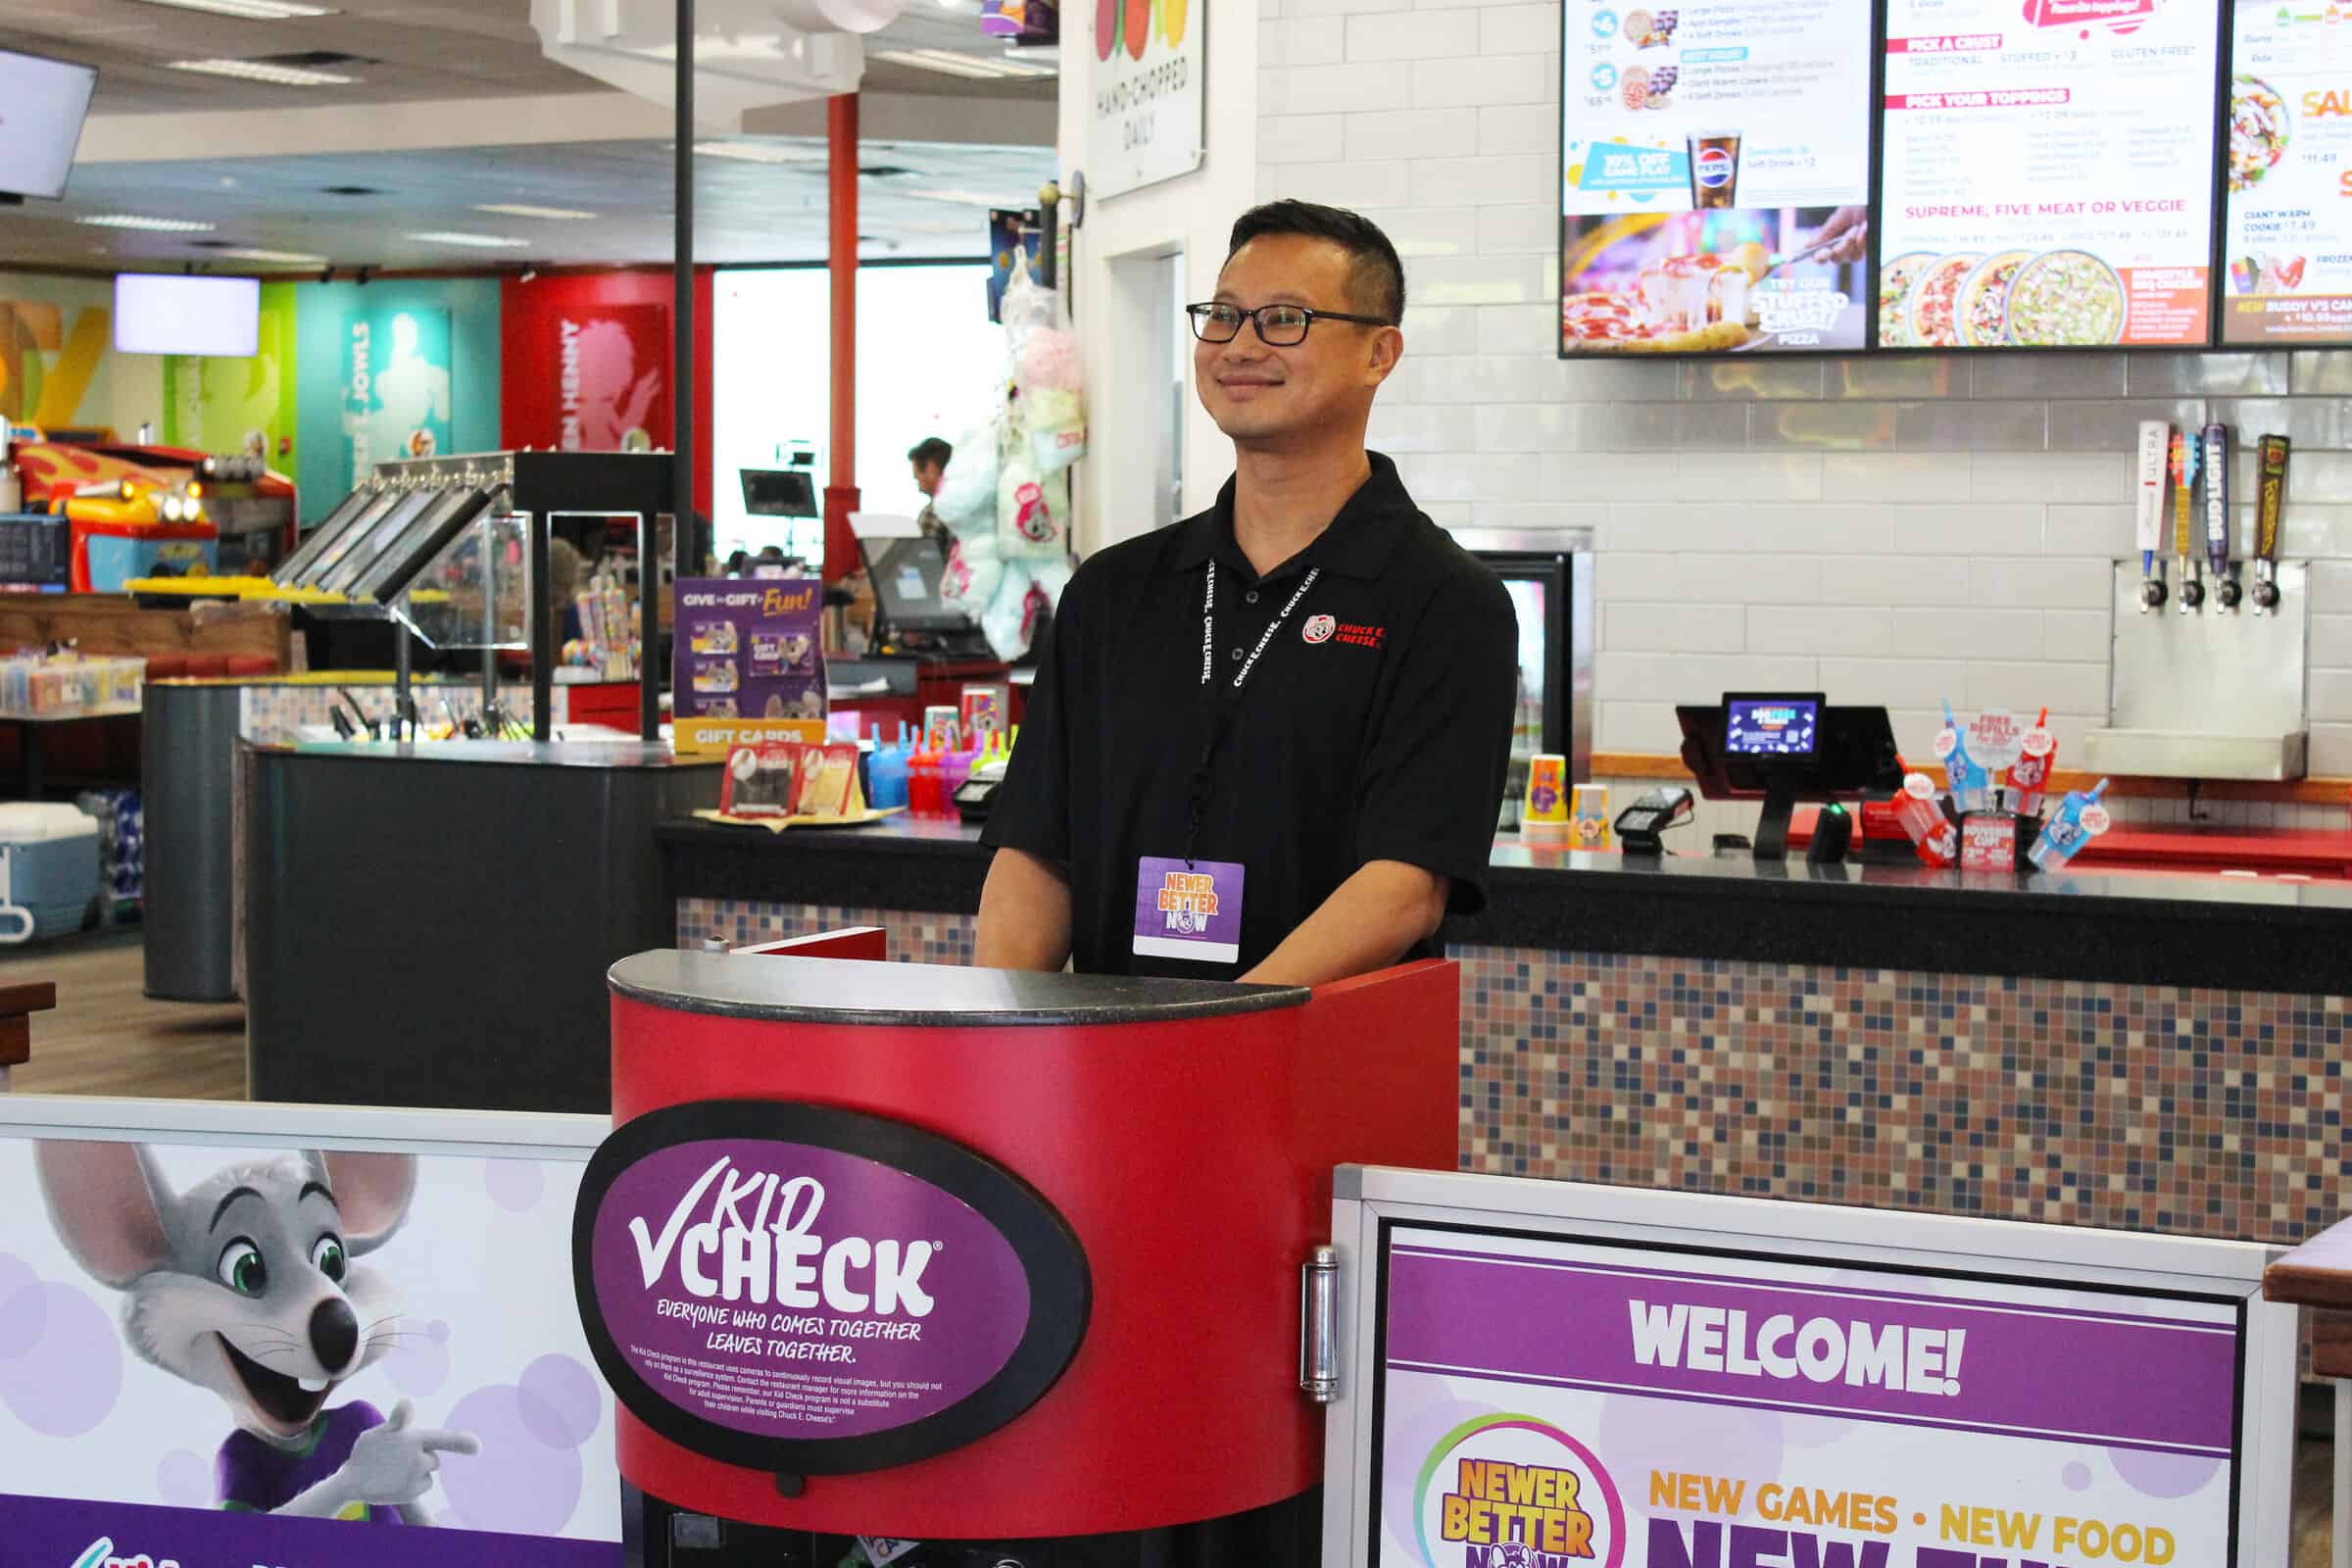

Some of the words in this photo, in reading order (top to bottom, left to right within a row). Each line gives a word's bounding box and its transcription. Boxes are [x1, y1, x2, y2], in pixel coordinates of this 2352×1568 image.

[1907, 38, 1939, 52] PICK
[1941, 36, 1953, 50] A
[1955, 35, 1999, 49] CRUST
[2111, 47, 2157, 59] GLUTEN
[1909, 55, 1983, 67] TRADITIONAL
[1999, 52, 2051, 64] STUFFED
[1907, 95, 1941, 109] PICK
[1943, 93, 1986, 108] YOUR
[1990, 90, 2068, 106] TOPPINGS
[1697, 164, 1731, 172] PEPSI
[1905, 204, 1990, 218] SUPREME,
[1995, 203, 2032, 217] FIVE
[2037, 202, 2084, 215] MEAT
[2090, 201, 2116, 214] OR
[2122, 199, 2186, 213] VEGGIE
[2244, 211, 2274, 220] GIANT
[2244, 222, 2280, 232] COOKIE
[1779, 333, 1820, 346] PIZZA
[353, 322, 368, 403] JOWLS
[683, 593, 715, 607] GIVE
[725, 592, 759, 607] GIFT
[762, 587, 812, 614] Fun!
[1338, 623, 1374, 636] CHUCK
[1969, 722, 2019, 737] REFILLS
[1980, 714, 2011, 726] FREE
[695, 728, 735, 744] GIFT
[739, 728, 803, 744] CARDS
[1165, 871, 1214, 894] NEWER
[1157, 888, 1219, 916] BETTER
[709, 1167, 826, 1237] KID
[658, 1298, 729, 1329] EVERYONE
[732, 1309, 767, 1329] WHO
[771, 1313, 825, 1335] COMES
[830, 1319, 922, 1342] TOGETHER
[706, 1332, 762, 1356] LEAVES
[766, 1340, 857, 1364] TOGETHER.
[1628, 1298, 1966, 1398] WELCOME!
[647, 1349, 660, 1358] Check
[662, 1352, 681, 1364] program
[682, 1356, 687, 1365] in
[688, 1357, 697, 1366] this
[698, 1360, 724, 1371] restaurant
[725, 1364, 739, 1373] uses
[740, 1367, 763, 1377] cameras
[772, 1371, 809, 1383] continuously
[811, 1375, 832, 1384] record
[833, 1376, 853, 1386] visual
[854, 1378, 878, 1389] images,
[880, 1380, 891, 1389] but
[906, 1381, 929, 1390] should
[673, 1375, 687, 1384] Check
[713, 1381, 730, 1391] Please
[774, 1390, 784, 1398] Kid
[785, 1391, 803, 1400] Check
[805, 1395, 831, 1404] program
[858, 1399, 889, 1408] substitute
[684, 1366, 713, 1379] surveillance
[737, 1375, 759, 1385] Contact
[760, 1378, 769, 1387] the
[771, 1381, 800, 1390] restaurant
[802, 1384, 828, 1395] manager
[830, 1386, 839, 1395] for
[858, 1388, 897, 1398] information
[698, 1389, 710, 1398] adult
[745, 1396, 767, 1406] Parents
[776, 1401, 806, 1411] guardians
[825, 1406, 855, 1415] supervise
[705, 1399, 716, 1409] their
[717, 1402, 740, 1412] children
[740, 1406, 756, 1415] while
[756, 1408, 777, 1418] visiting
[778, 1410, 797, 1420] Chuck
[1458, 1457, 1581, 1510] NEWER
[1442, 1492, 1595, 1559] BETTER
[1648, 1469, 1746, 1516] NEW
[1756, 1482, 1898, 1535] GAMES
[1939, 1502, 2043, 1551] NEW
[2053, 1515, 2176, 1566] FOOD
